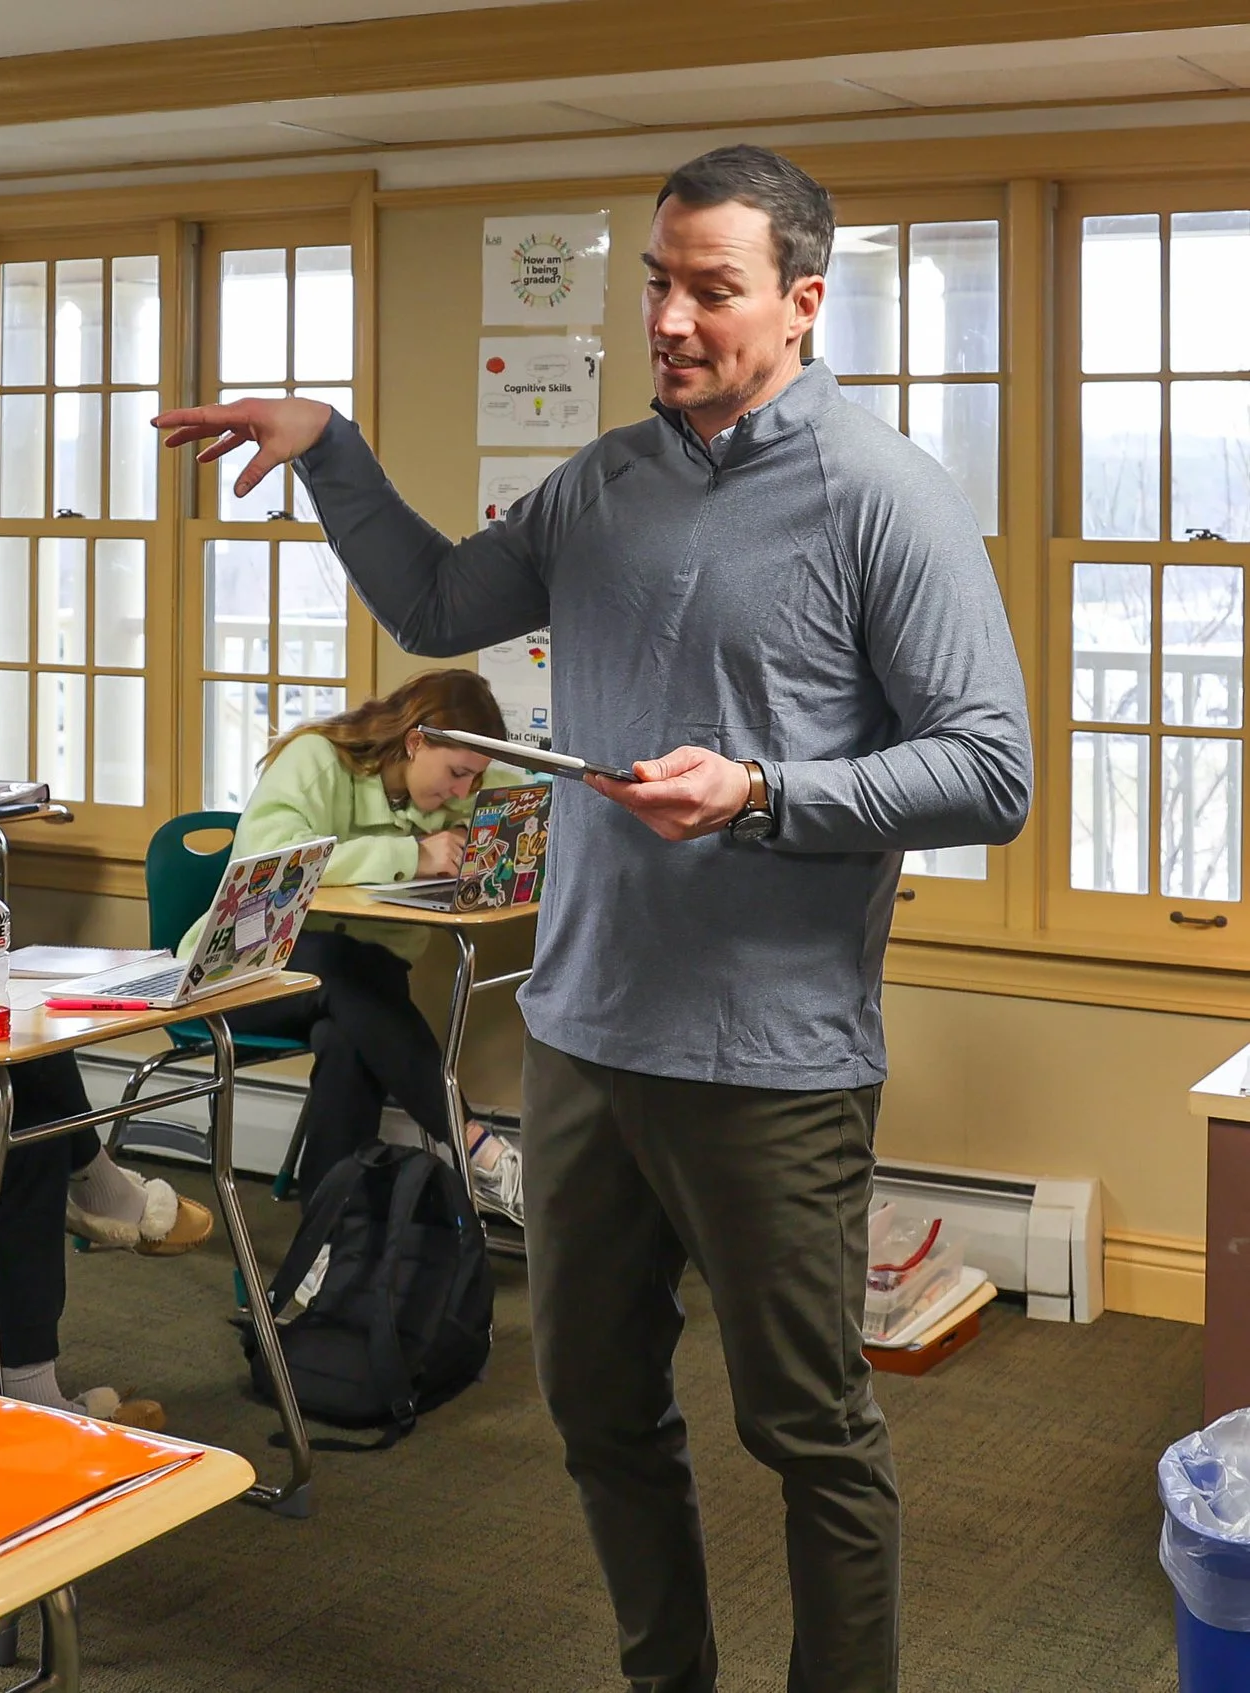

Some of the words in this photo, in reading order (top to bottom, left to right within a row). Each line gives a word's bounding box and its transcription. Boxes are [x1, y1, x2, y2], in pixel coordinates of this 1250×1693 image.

[523, 256, 545, 264] How
[532, 265, 558, 276] being
[523, 275, 561, 286] graded?
[504, 383, 546, 394] Cognitive
[548, 383, 572, 392] Skills
[526, 635, 550, 645] Skills
[507, 732, 521, 741] ital
[500, 791, 550, 818] Roost
